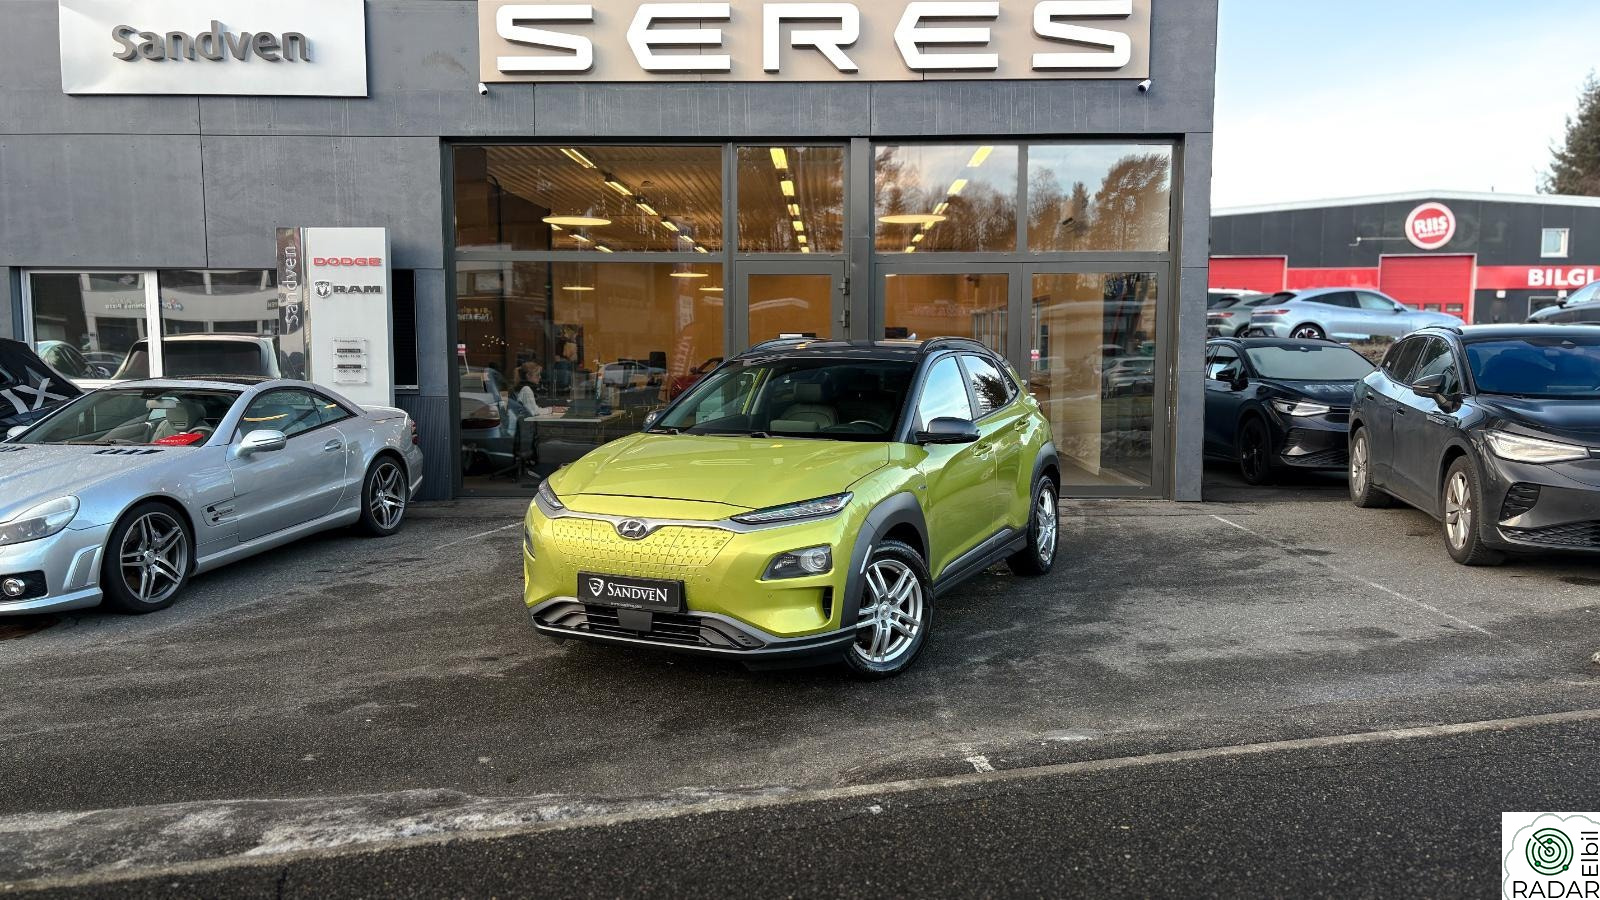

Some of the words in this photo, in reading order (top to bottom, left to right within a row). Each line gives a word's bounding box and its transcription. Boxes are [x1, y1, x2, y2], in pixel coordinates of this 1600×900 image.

[112, 19, 310, 62] Sandven
[495, 0, 1134, 73] SERES
[313, 257, 381, 267] DODGE
[333, 285, 382, 294] RAM
[607, 582, 669, 602] SANDVEN
